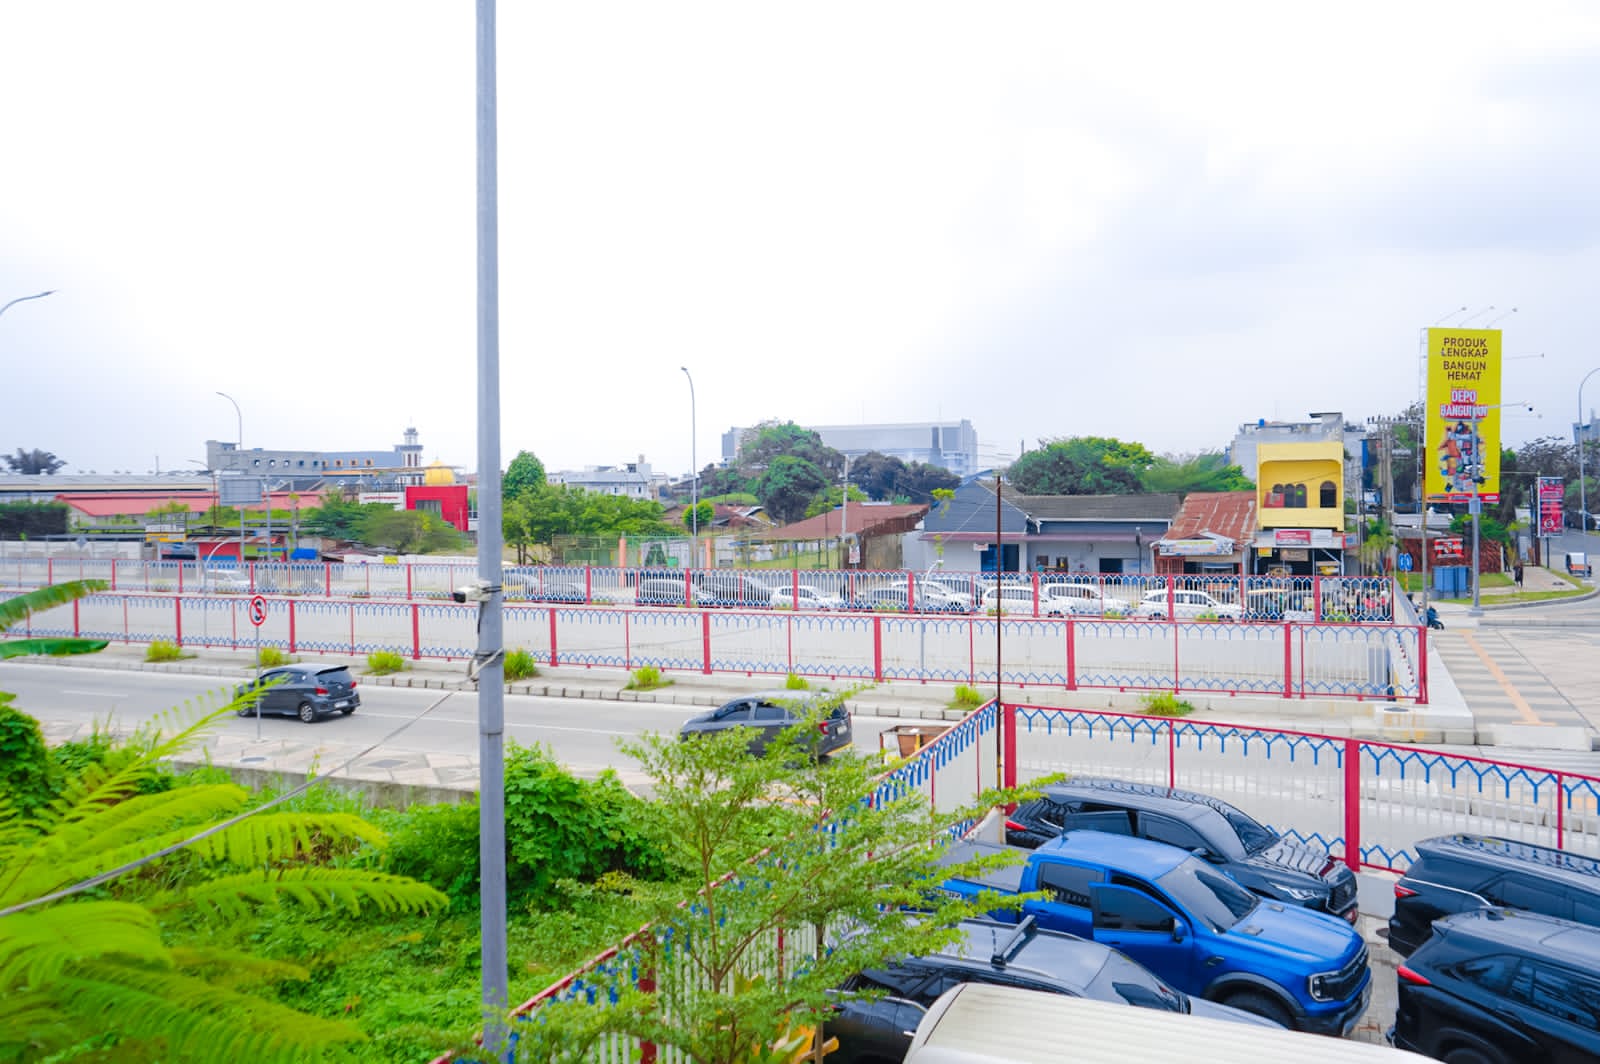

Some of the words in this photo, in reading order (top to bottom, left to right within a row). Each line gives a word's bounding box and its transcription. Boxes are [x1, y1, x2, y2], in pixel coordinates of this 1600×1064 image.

[1443, 337, 1487, 348] PRODUK
[1441, 347, 1489, 358] LENGKAP
[1443, 360, 1487, 371] BANGUN
[1447, 371, 1482, 381] HEMAT
[1451, 390, 1477, 403] DEPO
